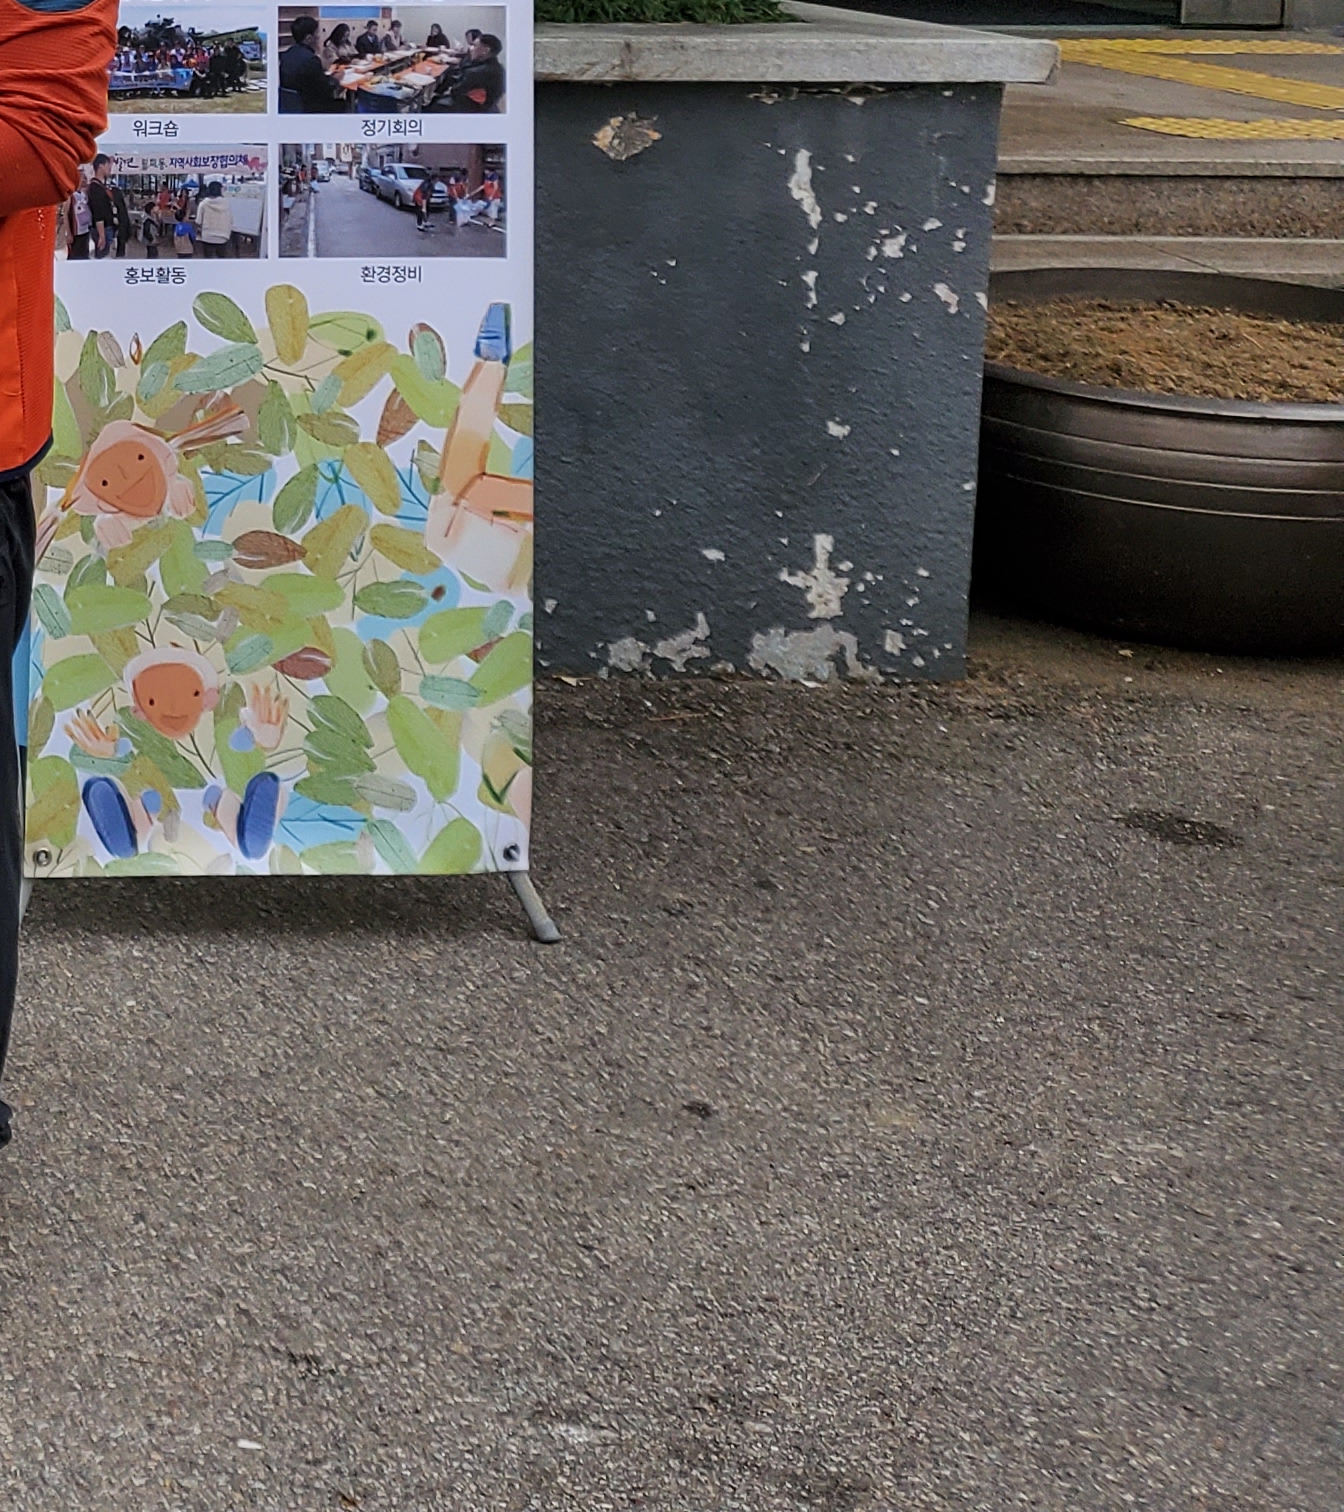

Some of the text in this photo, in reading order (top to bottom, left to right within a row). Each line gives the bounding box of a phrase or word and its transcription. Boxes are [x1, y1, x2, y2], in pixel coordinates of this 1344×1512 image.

[132, 119, 180, 138] 워크숍
[360, 118, 424, 138] 정기회의
[123, 266, 187, 286] 홍보활동
[360, 265, 424, 285] 환경정비
